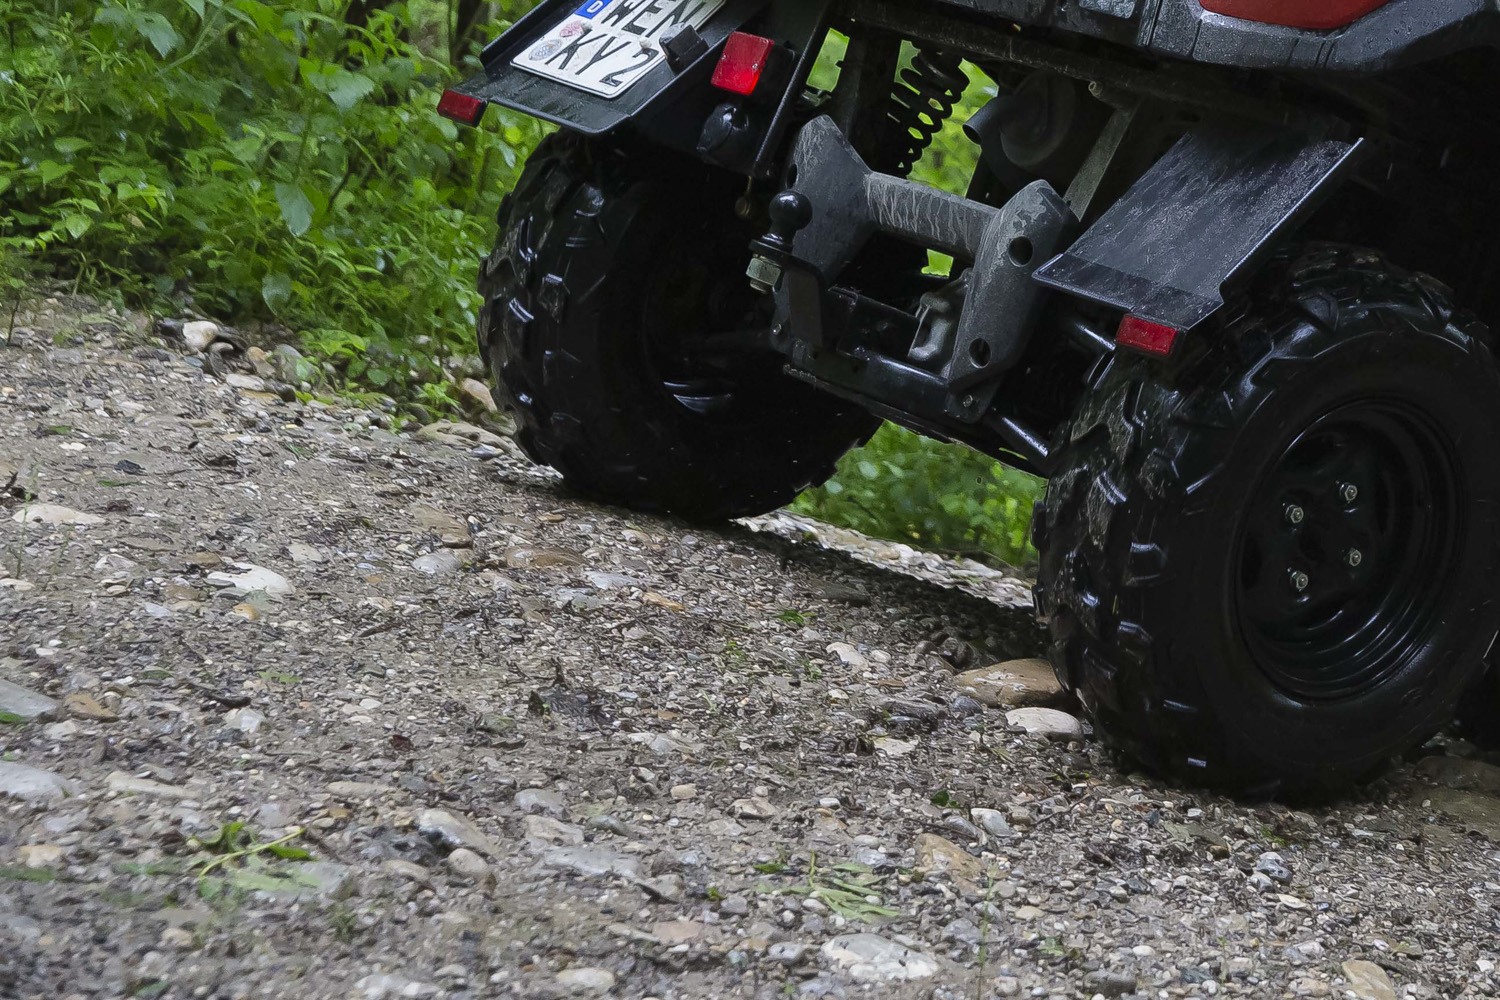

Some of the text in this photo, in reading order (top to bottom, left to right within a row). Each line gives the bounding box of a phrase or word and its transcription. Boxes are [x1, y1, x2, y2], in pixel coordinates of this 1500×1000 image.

[586, 0, 603, 14] D
[544, 28, 659, 87] KY 2
